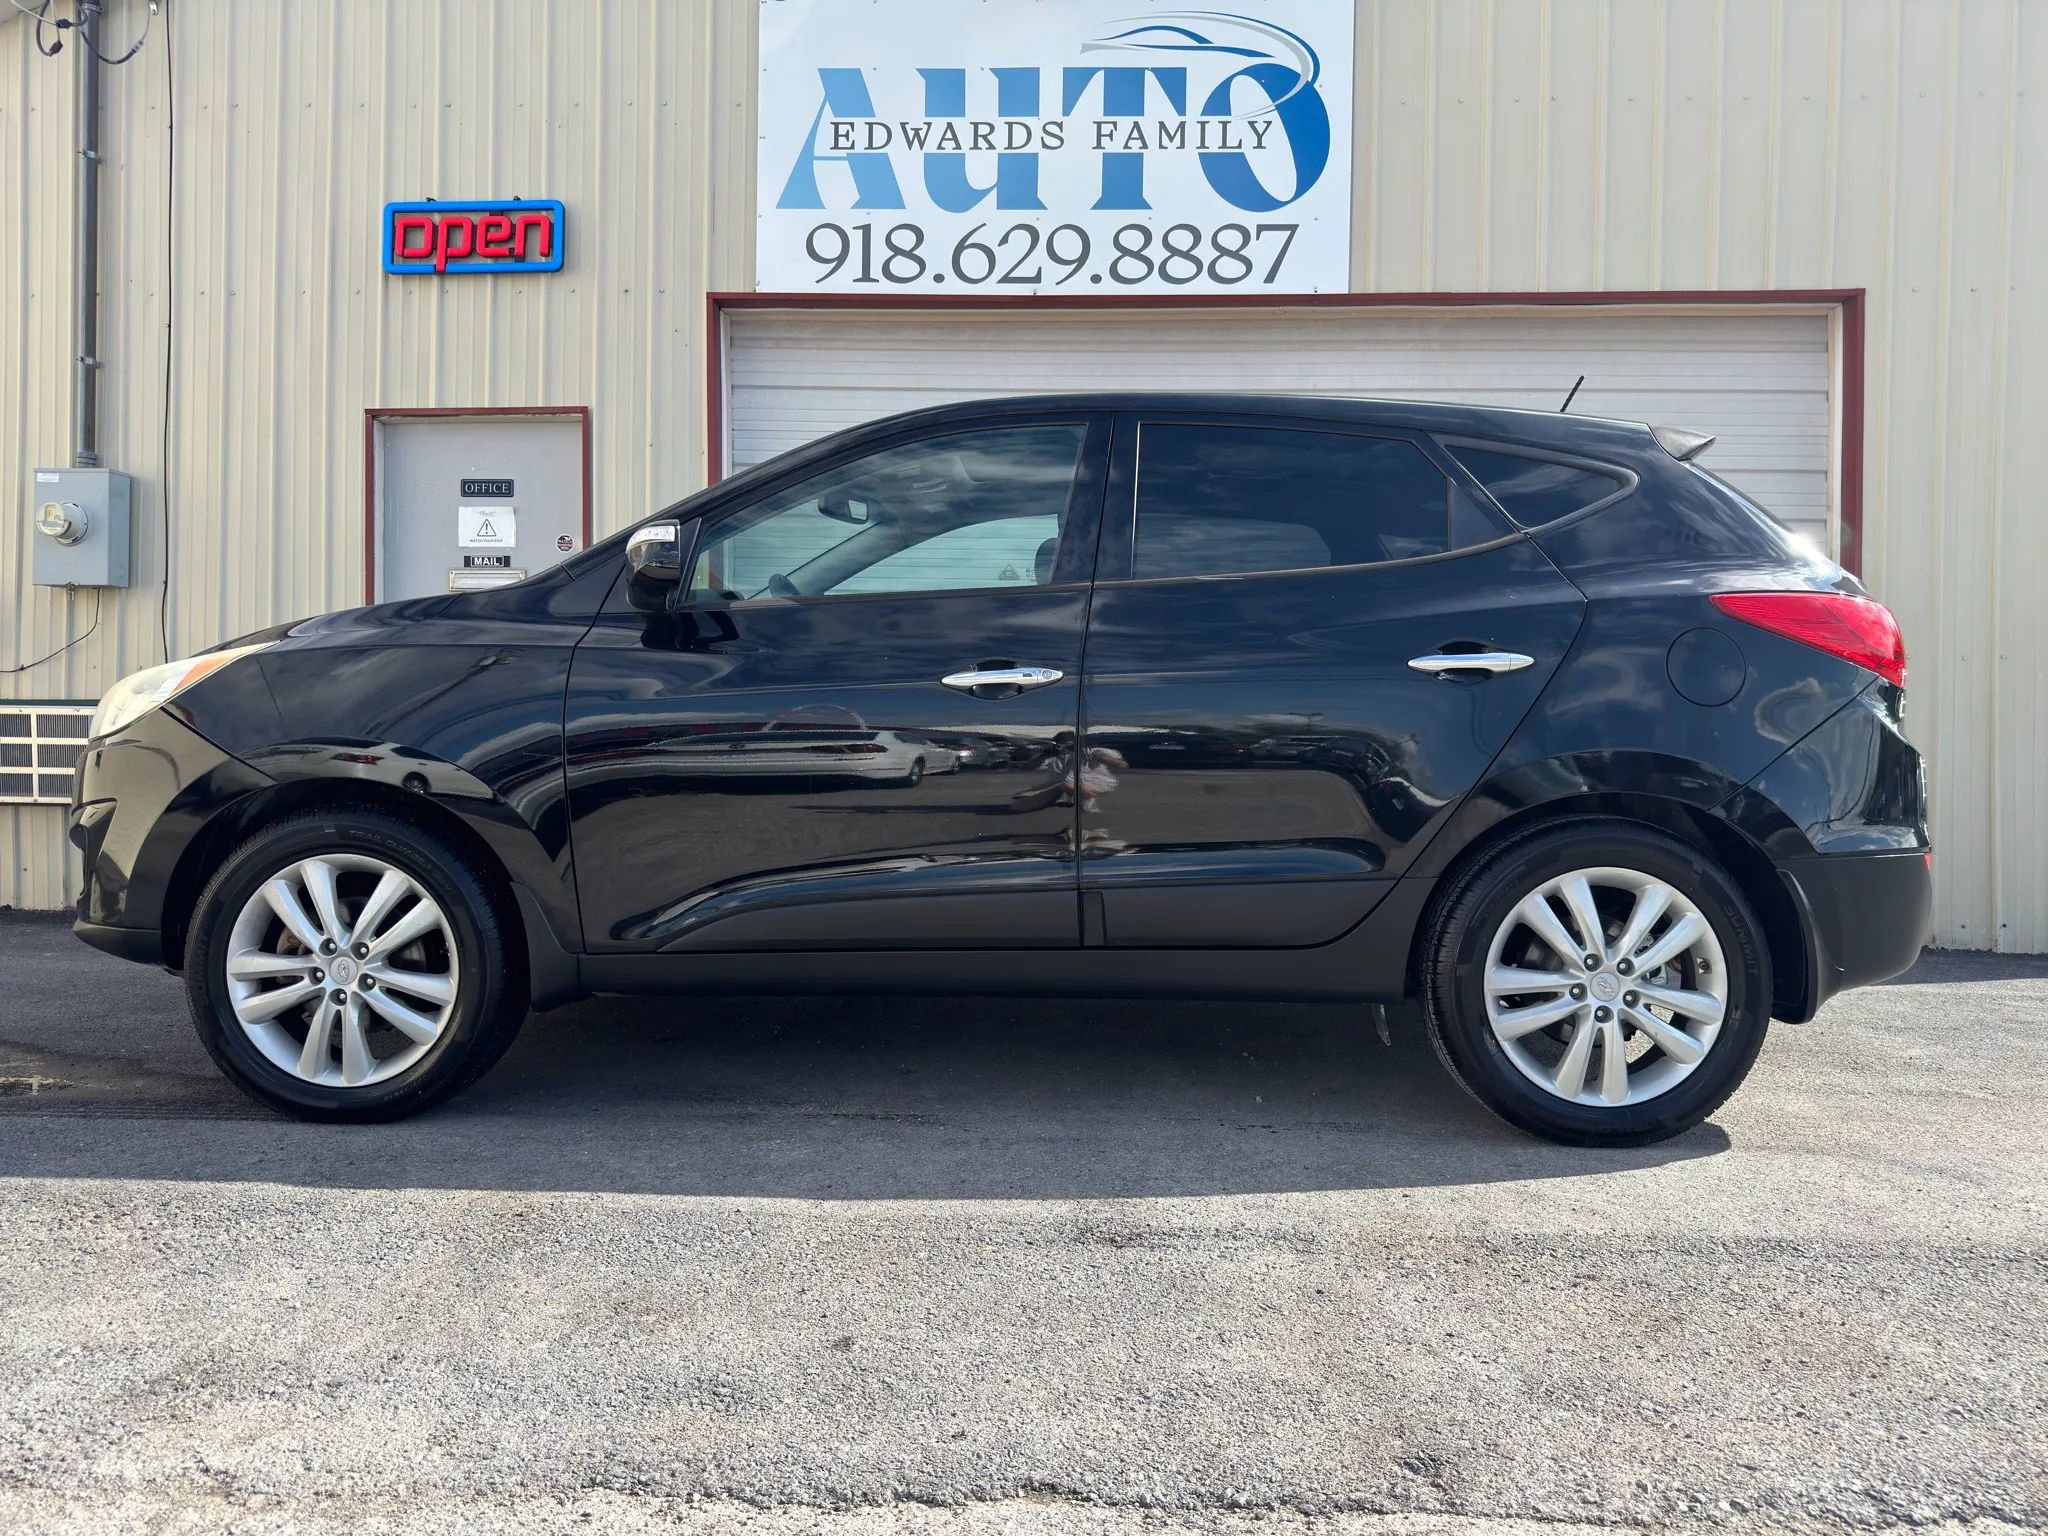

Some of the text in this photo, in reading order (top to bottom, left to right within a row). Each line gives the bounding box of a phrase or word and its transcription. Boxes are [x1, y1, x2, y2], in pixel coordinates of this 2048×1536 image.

[775, 62, 1331, 213] AUTO
[829, 119, 1274, 151] EDWARDS FAMILY
[395, 214, 551, 273] open
[805, 222, 1300, 286] 918.629.8887
[465, 482, 510, 493] OFFICE
[474, 557, 500, 566] MAIL
[1723, 904, 1759, 977] SUMMIT
